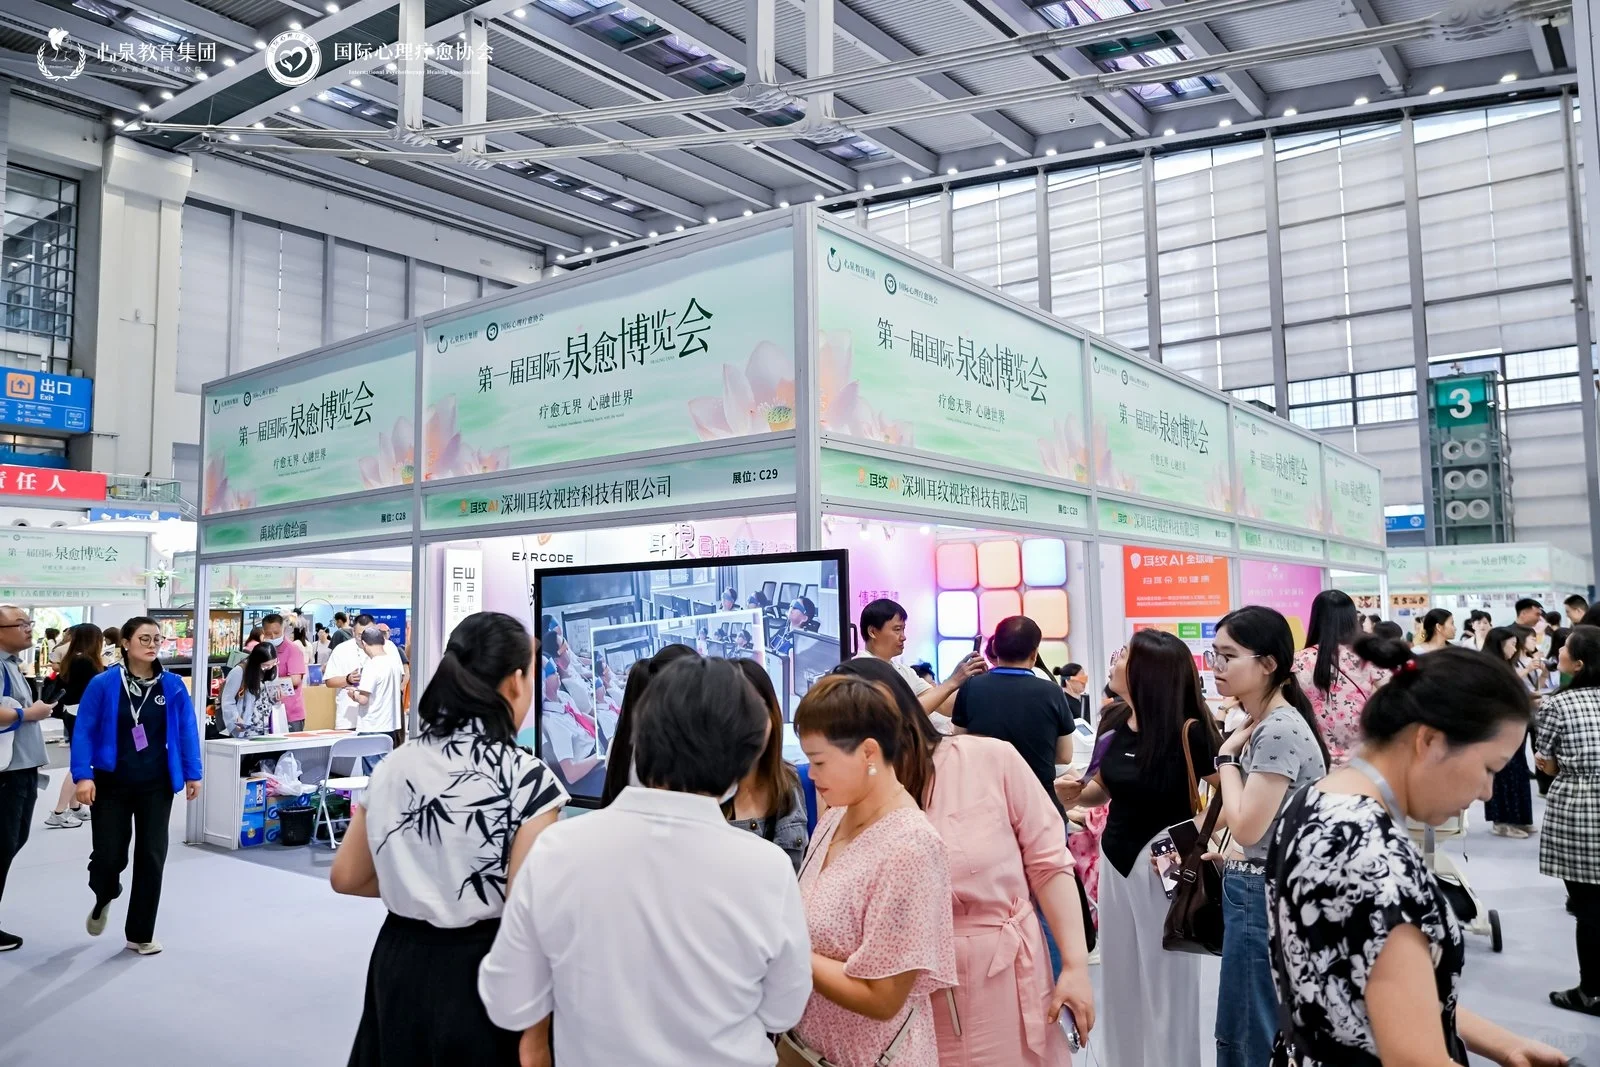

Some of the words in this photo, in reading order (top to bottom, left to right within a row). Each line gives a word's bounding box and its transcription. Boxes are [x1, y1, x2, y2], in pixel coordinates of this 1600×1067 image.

[477, 297, 714, 394] 第一届国际泉愈博览会
[876, 316, 1048, 405] 第一届国际泉愈博览会
[40, 379, 72, 396] 出口
[40, 394, 54, 402] Exit
[238, 380, 375, 447] 第一届国际泉愈博览会
[539, 398, 582, 419] 疗愈无界
[587, 388, 634, 411] 心融世界
[938, 394, 972, 415] 疗愈无界
[975, 404, 1006, 424] 心融世界
[1449, 388, 1473, 419] 3
[273, 453, 299, 470] 疗愈无界
[500, 474, 672, 516] 深圳耳纹视控科技有限公司
[902, 473, 1029, 514] 深圳耳纹视控科技有限公司
[511, 551, 574, 564] EARCODE
